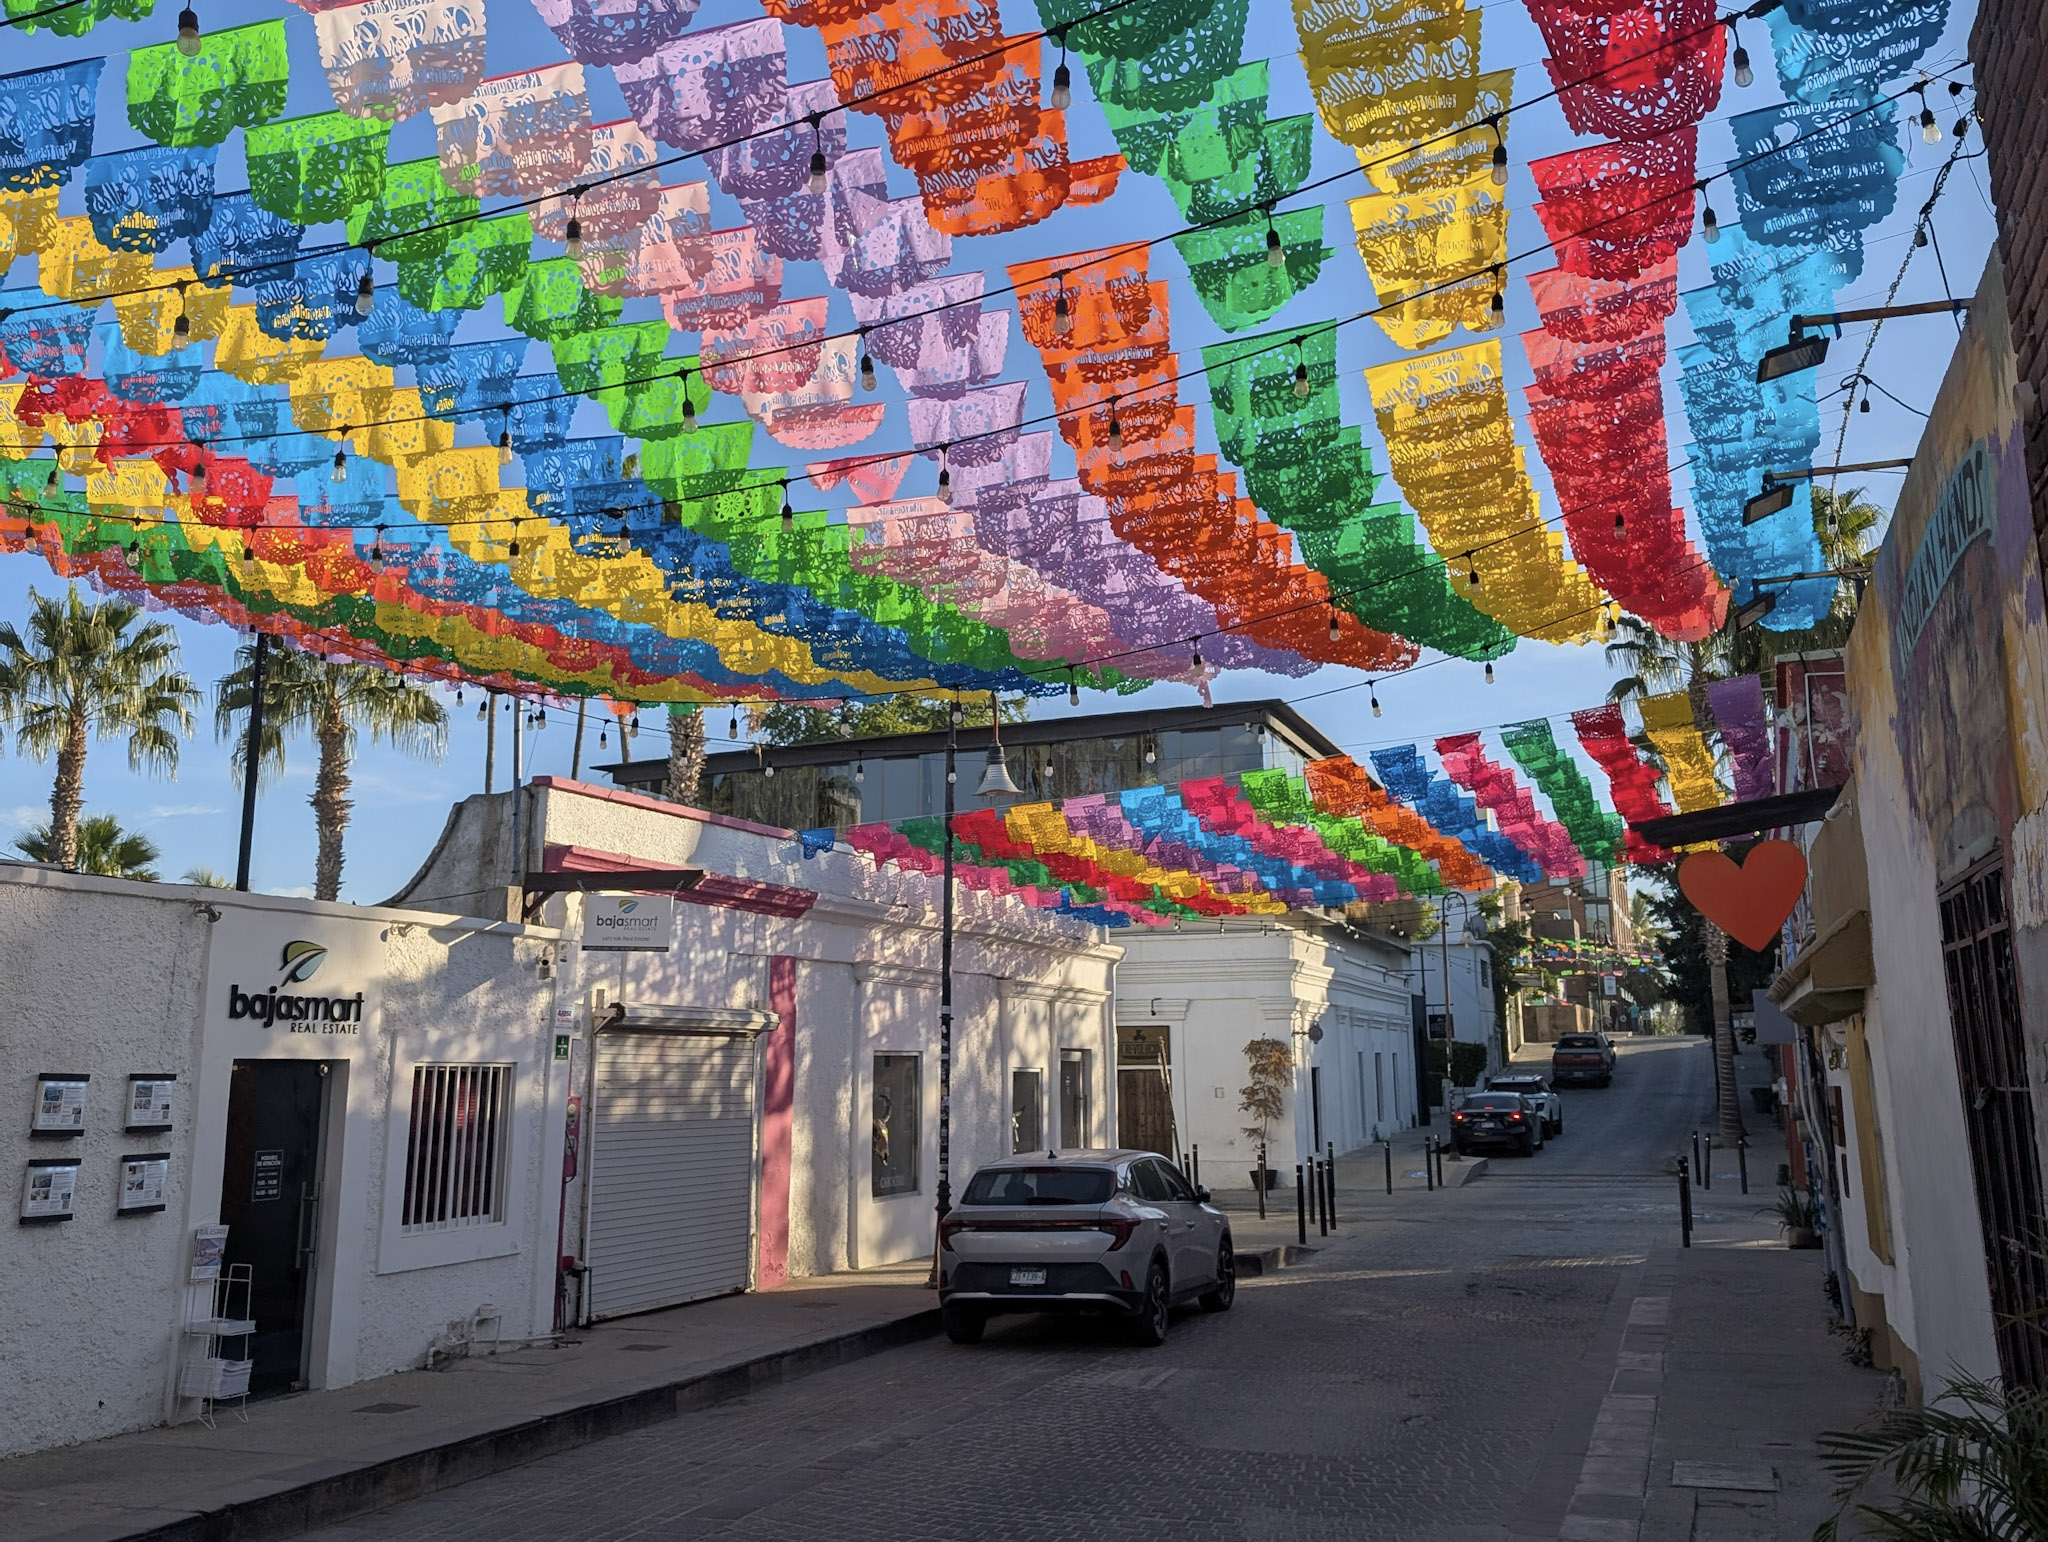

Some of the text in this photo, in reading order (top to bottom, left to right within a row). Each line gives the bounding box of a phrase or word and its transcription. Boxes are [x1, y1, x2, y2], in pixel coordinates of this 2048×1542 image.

[1898, 450, 1984, 661] INDIAN HANDS
[596, 914, 659, 929] bajasmart
[229, 984, 365, 1028] bajasmart
[290, 1022, 359, 1034] REAL ESTATE
